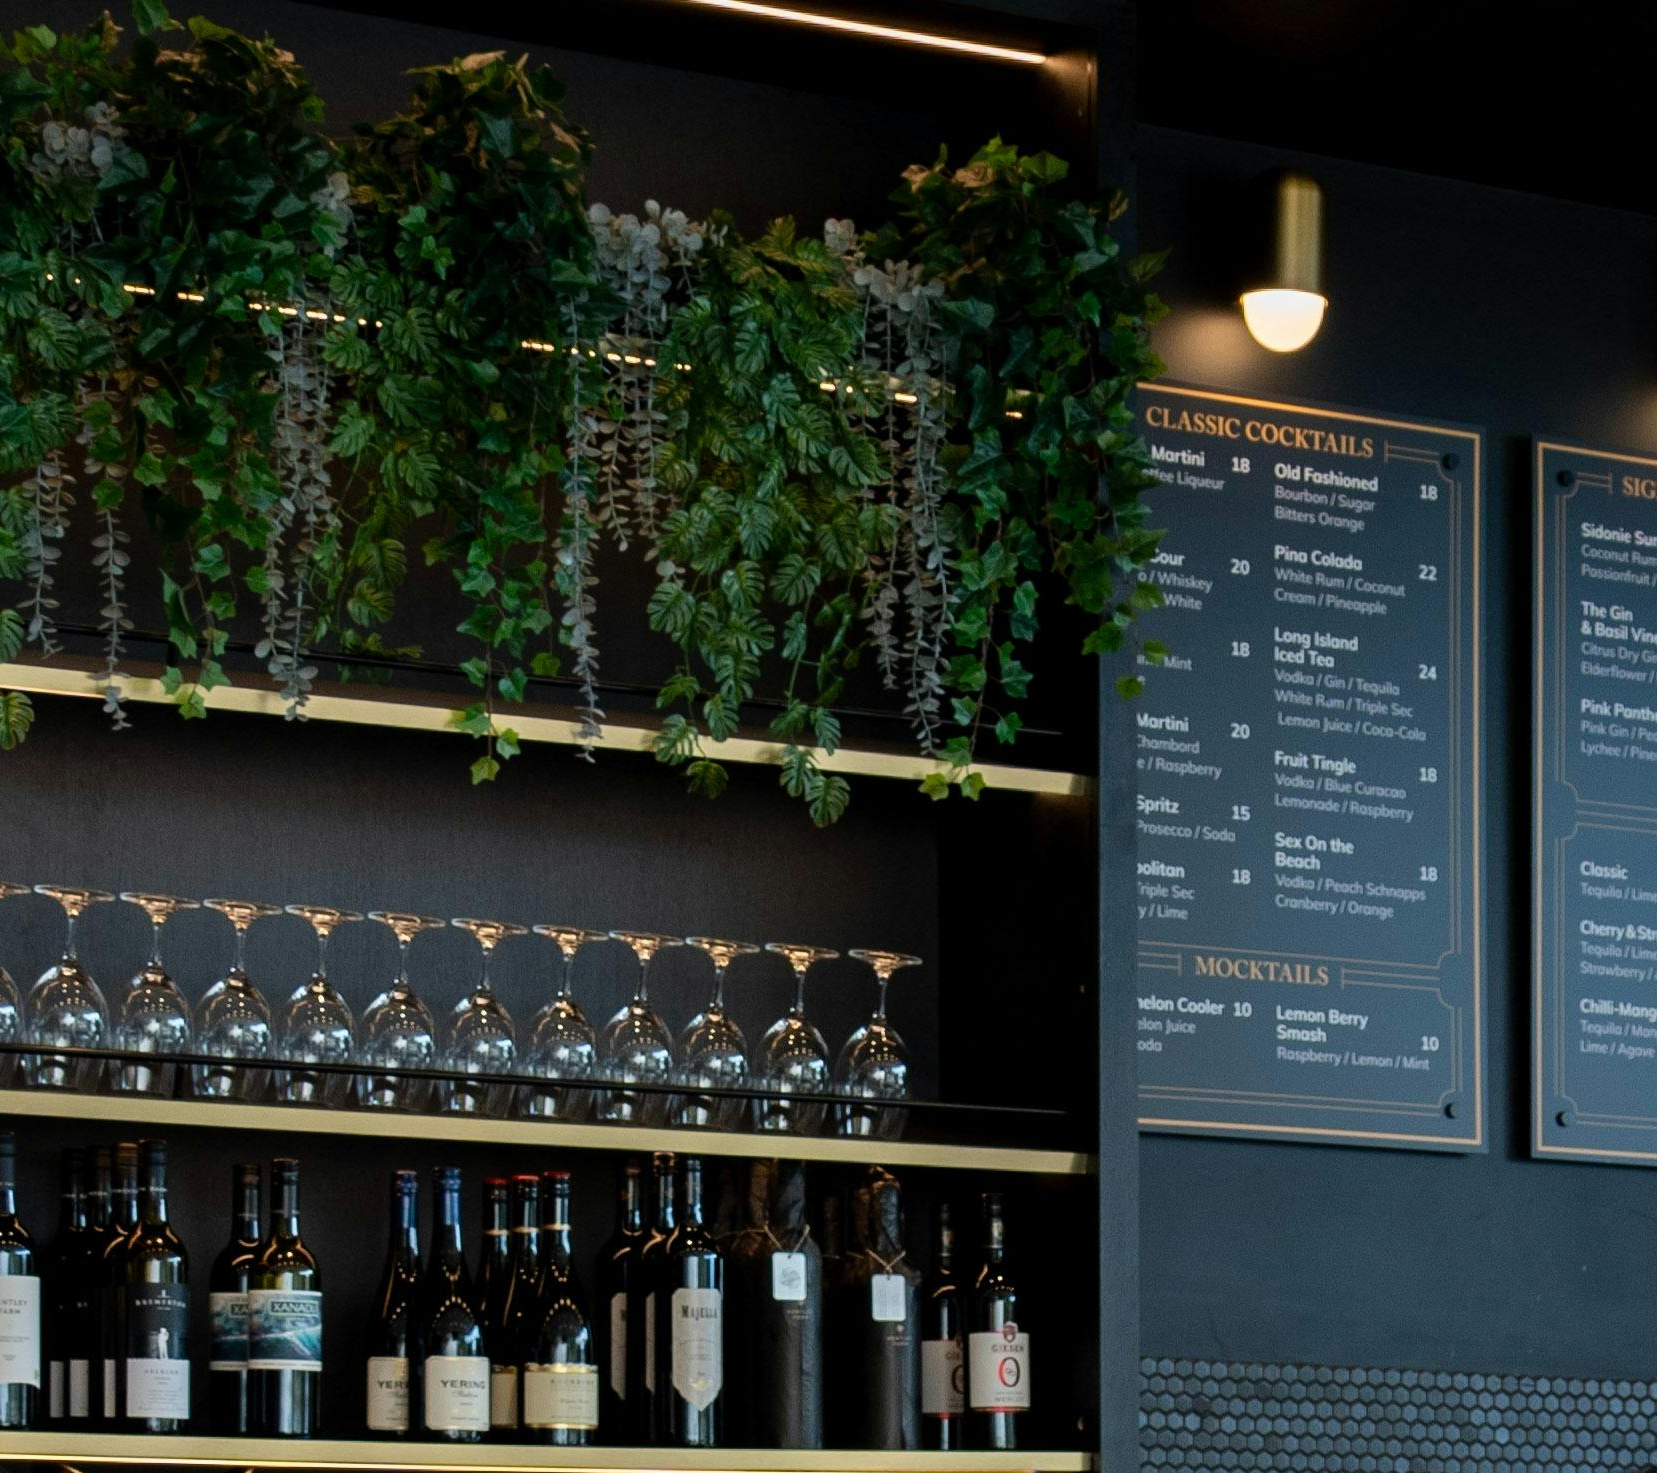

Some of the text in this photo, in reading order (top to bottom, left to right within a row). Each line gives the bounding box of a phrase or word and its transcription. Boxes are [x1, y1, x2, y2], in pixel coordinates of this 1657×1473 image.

[1146, 407, 1373, 457] CLASSIC COCKTAILS
[1152, 445, 1204, 466] Martini
[1232, 457, 1250, 473] 18
[1275, 463, 1378, 491] Old Fashioned
[1421, 485, 1438, 500] 18
[1581, 523, 1631, 543] Sidonie
[1311, 550, 1362, 570] Colada
[1419, 565, 1437, 581] 22
[1275, 627, 1358, 651] Long Island
[1275, 647, 1334, 667] Iced Tea
[1420, 664, 1436, 679] 24
[1581, 699, 1611, 716] Pink
[1275, 751, 1356, 776] Fruit Tingle
[1420, 767, 1437, 782] 18
[1275, 832, 1354, 854] Sex On the
[1275, 852, 1320, 869] Beach
[1580, 861, 1628, 879] Classic
[1421, 867, 1437, 881] 18
[1195, 956, 1330, 986] MOCKTAILS
[1277, 1005, 1368, 1030] Lemon Berry
[1277, 1024, 1326, 1042] Smash
[1422, 1036, 1439, 1051] 10
